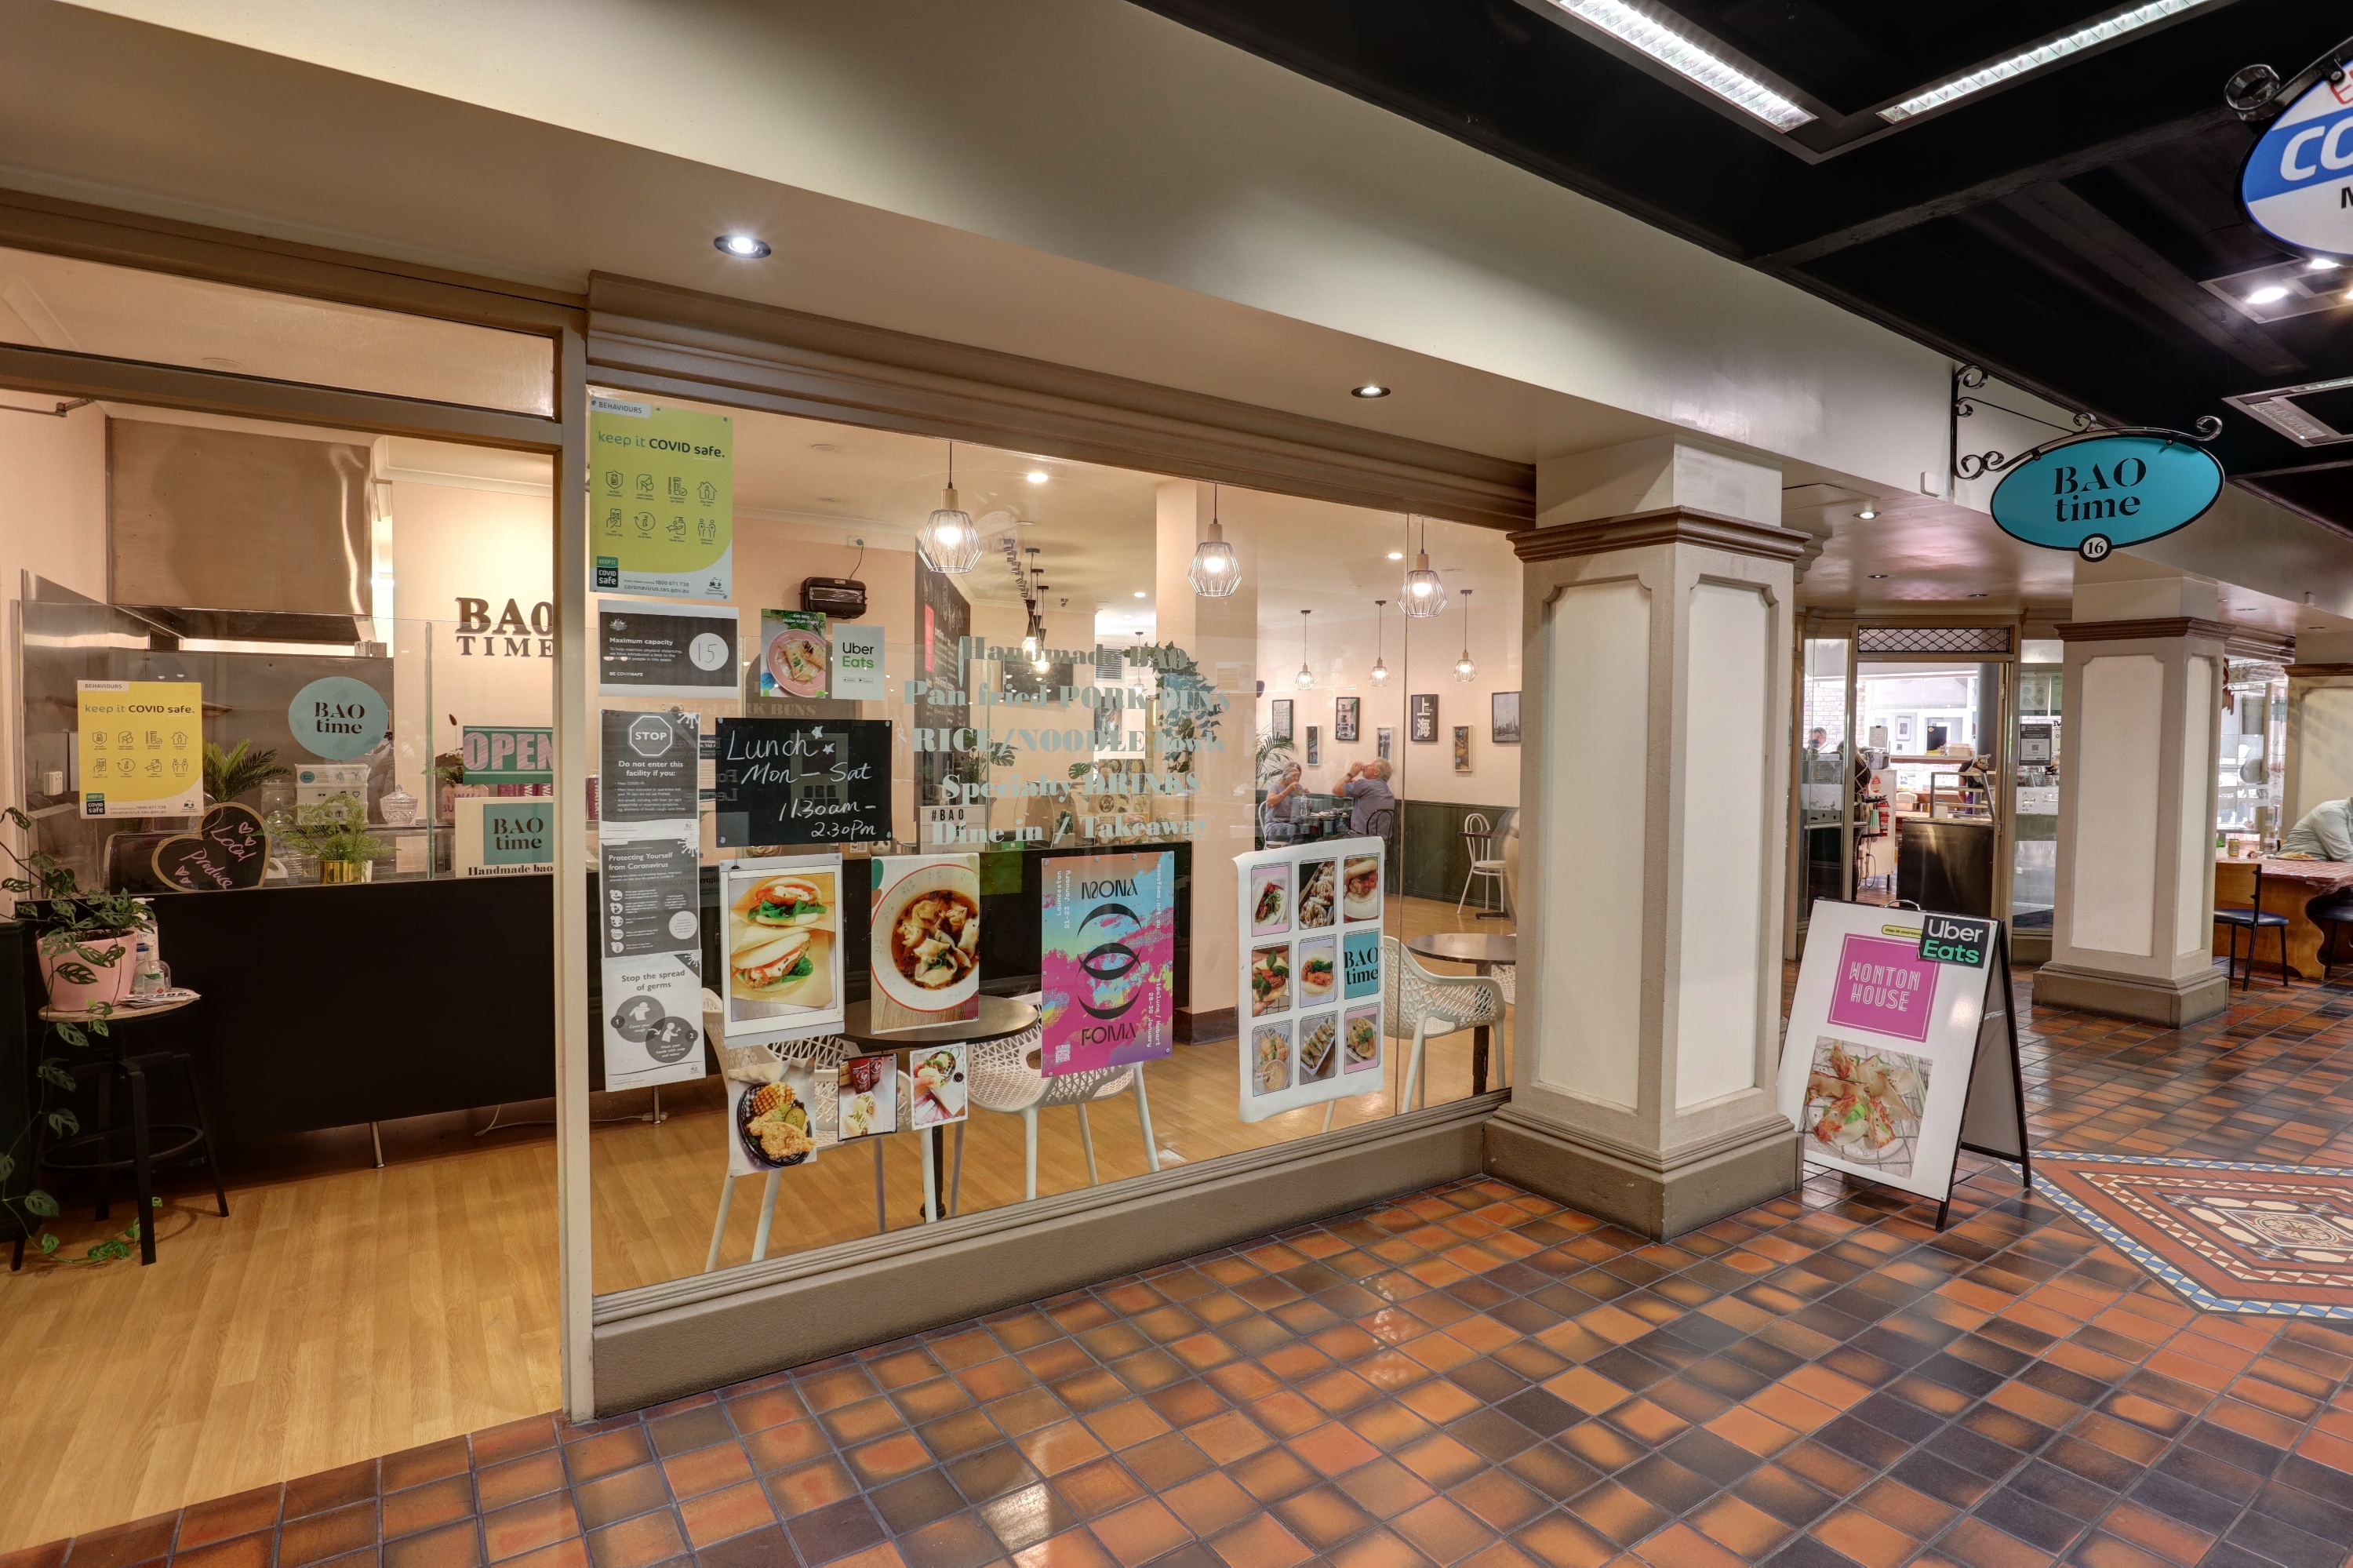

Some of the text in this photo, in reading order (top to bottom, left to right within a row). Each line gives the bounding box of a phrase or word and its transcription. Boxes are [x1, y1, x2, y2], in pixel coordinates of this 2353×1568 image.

[598, 401, 642, 414] BEHAVIOURS
[598, 431, 726, 457] keep it COVID safe.
[2053, 457, 2146, 496] BAO
[2054, 495, 2141, 523] time
[2086, 540, 2104, 555] 16
[598, 577, 616, 585] safe
[624, 585, 689, 594] coronavirus.tas.gov.au
[455, 597, 553, 637] BAO
[456, 635, 553, 657] TIME
[698, 642, 717, 664] 15
[842, 642, 875, 655] Uber
[962, 636, 1187, 670] Handmade BAO
[842, 655, 875, 668] Eats
[903, 679, 1231, 713] Pan fried PORK BUNS
[85, 704, 114, 715] keep
[117, 704, 125, 713] it
[129, 704, 165, 713] COVID
[315, 701, 365, 719] BAO
[1417, 697, 1431, 737] 上海
[316, 719, 362, 734] time
[635, 731, 667, 740] STOP
[463, 732, 553, 771] OPEN
[726, 729, 820, 761] Lunch
[911, 727, 1225, 757] RICE/NOODLE bowls
[741, 762, 798, 785] Mon
[829, 762, 872, 782] Sat
[942, 770, 1202, 806] Specialty DRINKS
[931, 808, 964, 821] #BAO
[493, 817, 544, 835] BAO
[931, 820, 1005, 846] Dine
[1014, 818, 1044, 842] in
[1080, 815, 1206, 840] Takeaway
[210, 824, 257, 862] Local
[495, 835, 542, 850] time
[179, 847, 233, 890] Produce
[467, 864, 553, 876] Handmade bao
[627, 861, 669, 870] Coronavirus
[1081, 879, 1139, 900] MONA
[1928, 919, 1984, 943] Uber
[1344, 946, 1379, 970] BAO
[1922, 939, 1980, 964] Eats
[659, 970, 686, 978] spread
[1346, 966, 1379, 986] time
[1848, 961, 1922, 991] WONTON
[636, 982, 671, 991] of germs
[1849, 982, 1911, 1013] HOUSE
[1081, 1022, 1137, 1046] FOMA
